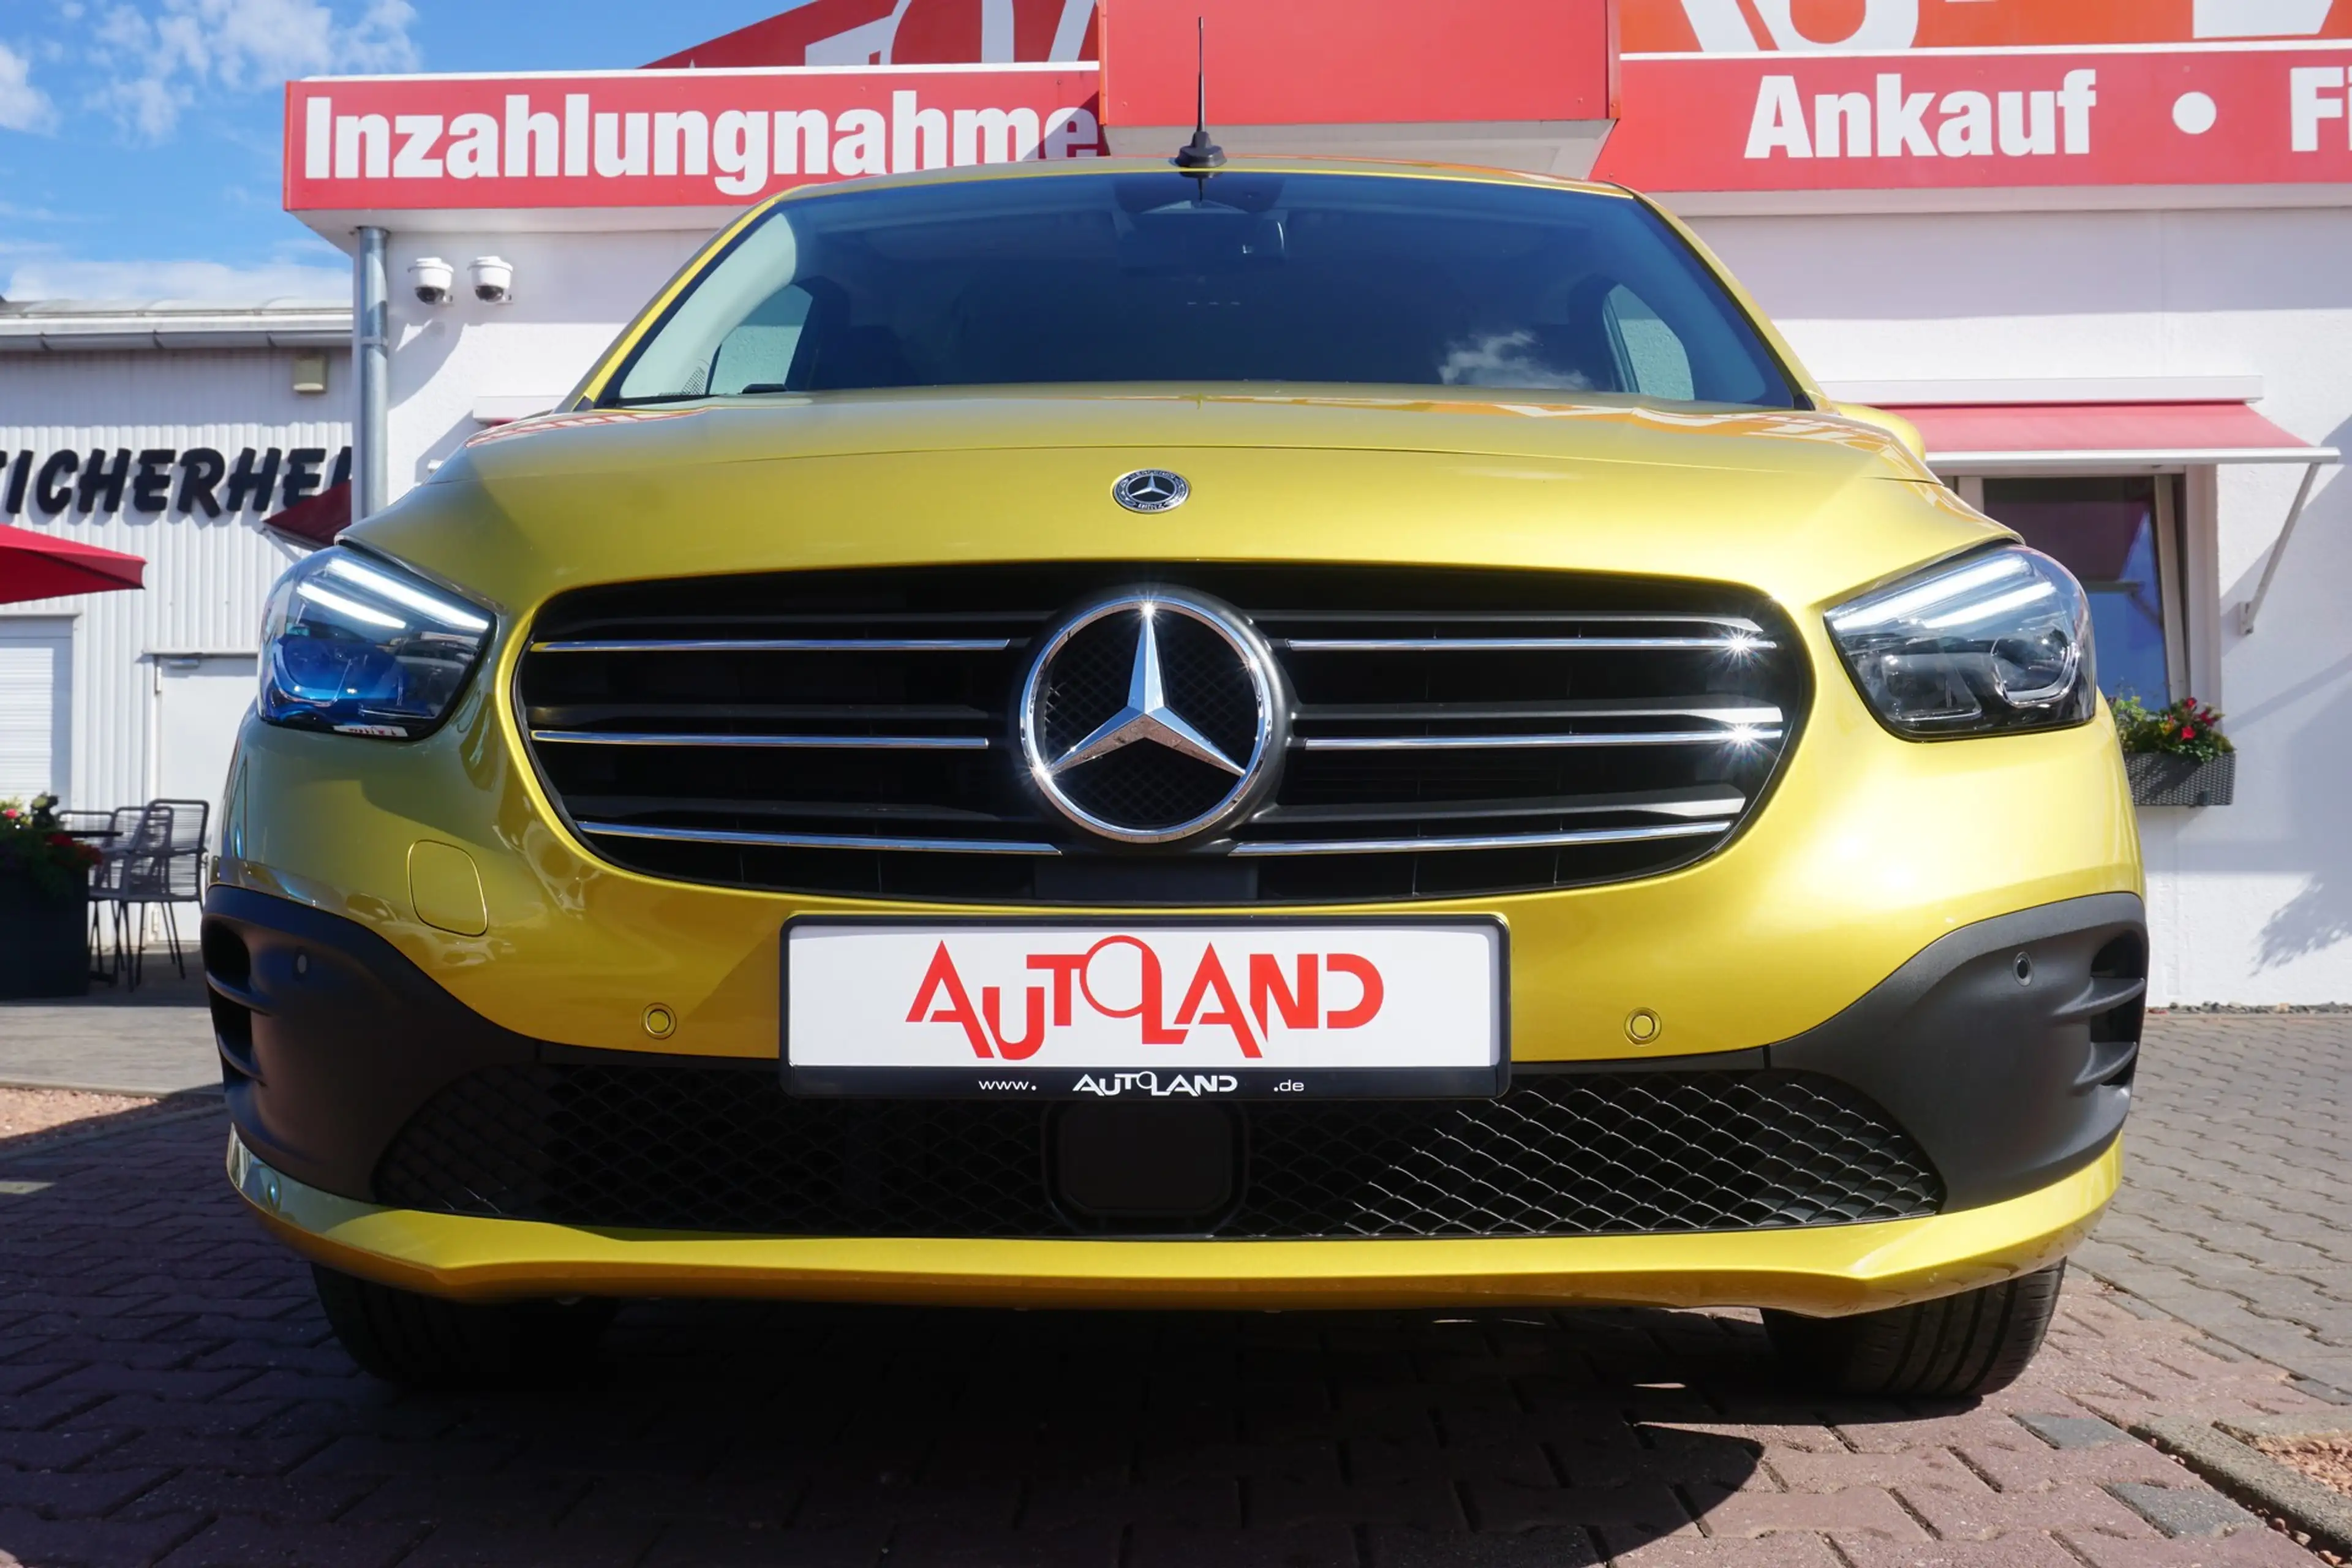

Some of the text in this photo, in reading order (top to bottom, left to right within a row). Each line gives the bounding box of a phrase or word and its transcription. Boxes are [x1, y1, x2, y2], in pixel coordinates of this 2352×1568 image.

[304, 89, 1098, 197] Inzahlungnahme
[1744, 69, 2097, 159] Ankauf
[978, 1080, 1037, 1091] www.
[1273, 1079, 1305, 1092] .de
